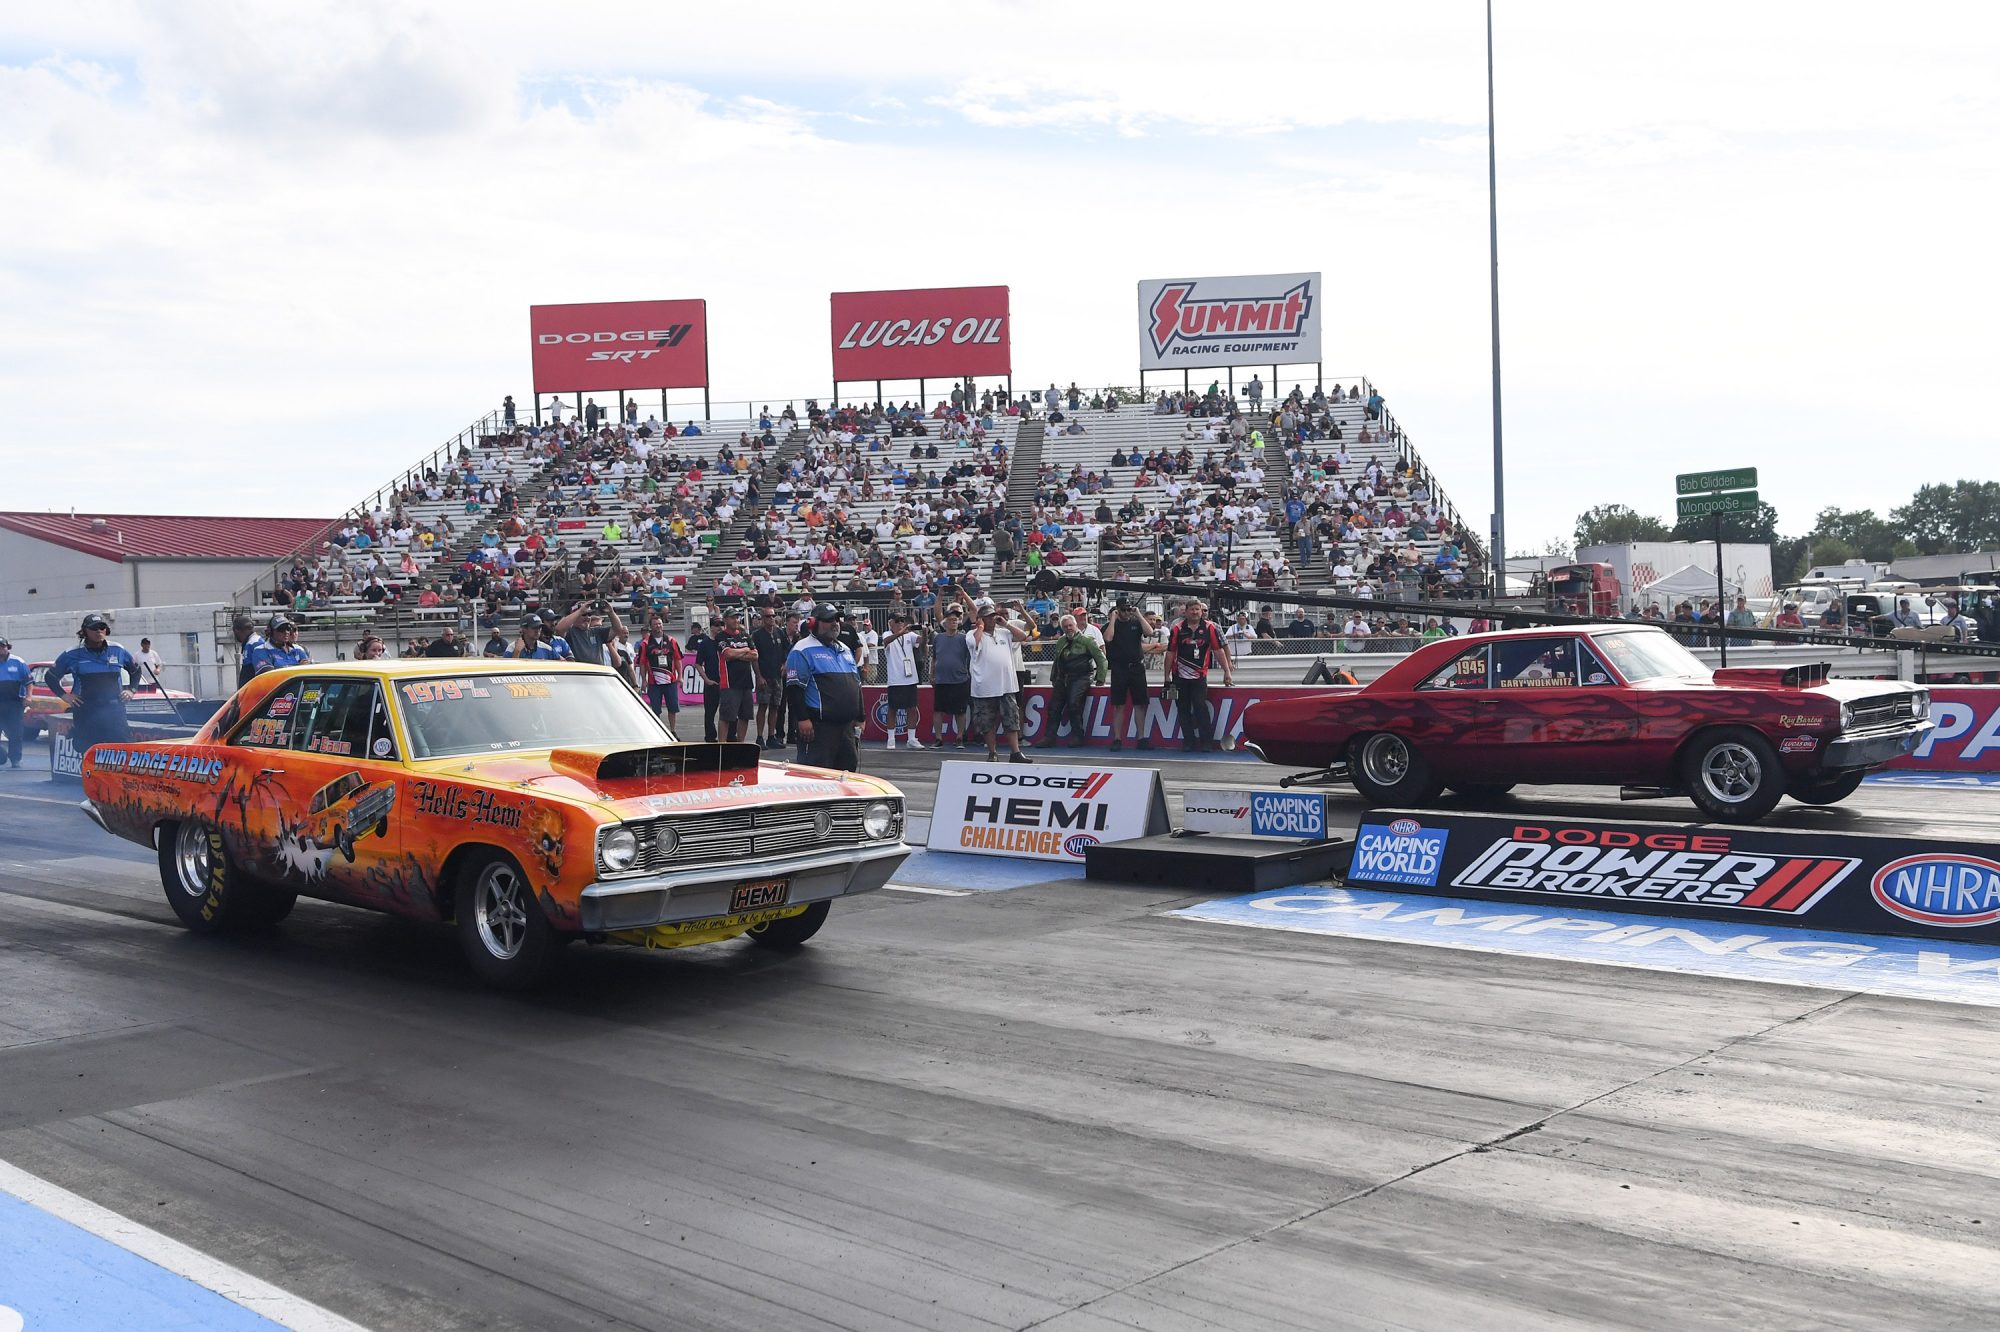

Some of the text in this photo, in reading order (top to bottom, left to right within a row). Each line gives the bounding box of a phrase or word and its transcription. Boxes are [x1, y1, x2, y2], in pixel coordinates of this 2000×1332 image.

[539, 330, 671, 345] DODGE
[839, 317, 1003, 349] LUCAS OIL
[586, 350, 660, 364] SRT
[1172, 342, 1299, 355] RACING EQUIPMENT
[1680, 478, 1699, 491] Bob
[1700, 475, 1736, 489] Glidden
[1680, 496, 1740, 513] Mongoo$e
[1455, 659, 1486, 675] 1945
[402, 680, 463, 704] 1979
[1500, 677, 1573, 688] GARY WOLKWITZ
[1780, 714, 1822, 728] Ray Barton
[94, 748, 223, 785] WIND RIDGE FARMS
[971, 773, 1089, 789] DODGE
[648, 783, 840, 807] BAUM COMPETITION
[1254, 796, 1320, 815] CAMPING
[964, 795, 1108, 831] HEMI
[1186, 807, 1238, 815] DODGE
[1255, 812, 1320, 833] WORLD
[1393, 822, 1417, 833] NHRA
[960, 825, 1062, 855] CHALLENGE
[1360, 834, 1440, 855] CAMPING
[1511, 826, 1732, 853] DODGE
[1359, 850, 1437, 875] WORLD
[1464, 841, 1776, 886] POWER
[1355, 871, 1431, 884] DRAG RACING SERIES
[1488, 867, 1756, 904] BROKERS
[734, 884, 785, 909] HEMI
[1895, 866, 2000, 911] NHRA
[1249, 894, 1878, 966] CAMPING
